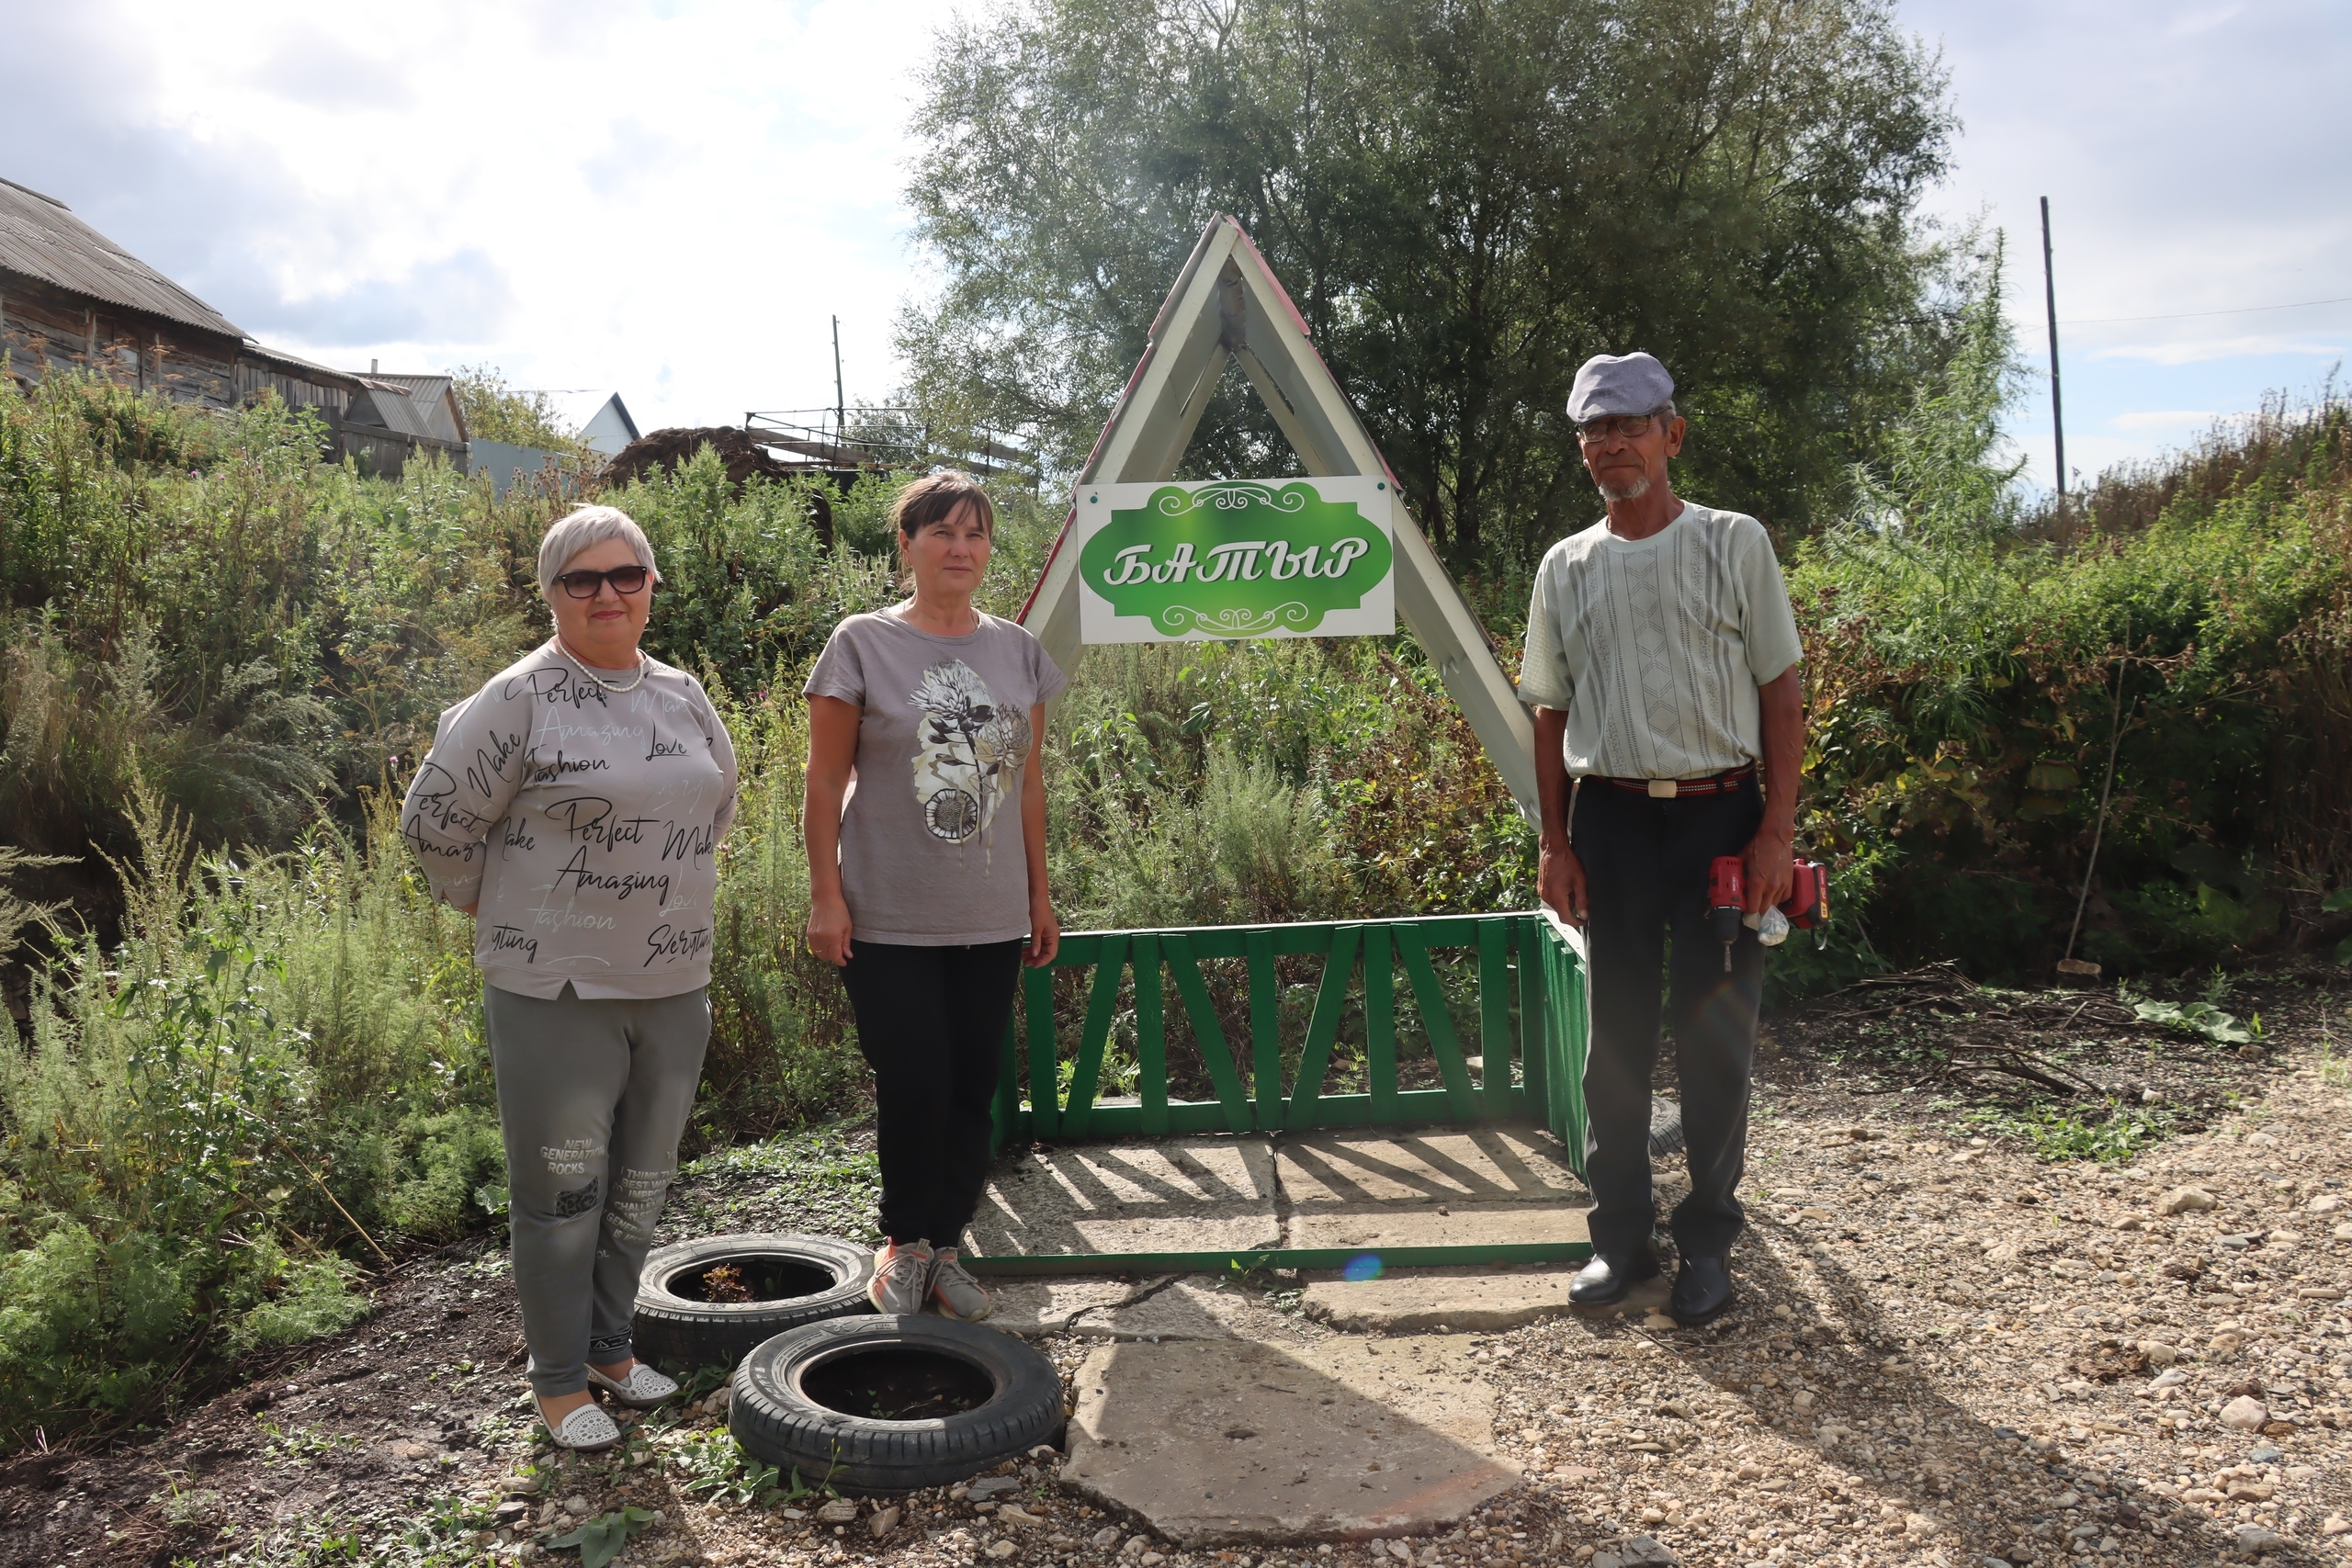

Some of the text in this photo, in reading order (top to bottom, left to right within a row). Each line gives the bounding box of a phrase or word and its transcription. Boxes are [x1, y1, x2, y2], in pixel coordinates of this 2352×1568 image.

[1103, 536, 1370, 585] БАТЫР
[504, 667, 620, 709] Perfect
[535, 705, 647, 752] Amazing
[645, 717, 692, 761] Love
[467, 730, 521, 798] Make
[409, 761, 493, 833] Perfect
[545, 796, 661, 853] Perfect
[552, 845, 670, 906] Amazing
[526, 884, 616, 933] Fashion
[539, 1145, 605, 1161] GENERATION
[563, 1138, 593, 1150] NEW
[547, 1161, 585, 1176] ROCKS
[621, 1178, 650, 1190] BEST
[627, 1168, 658, 1180] THINK
